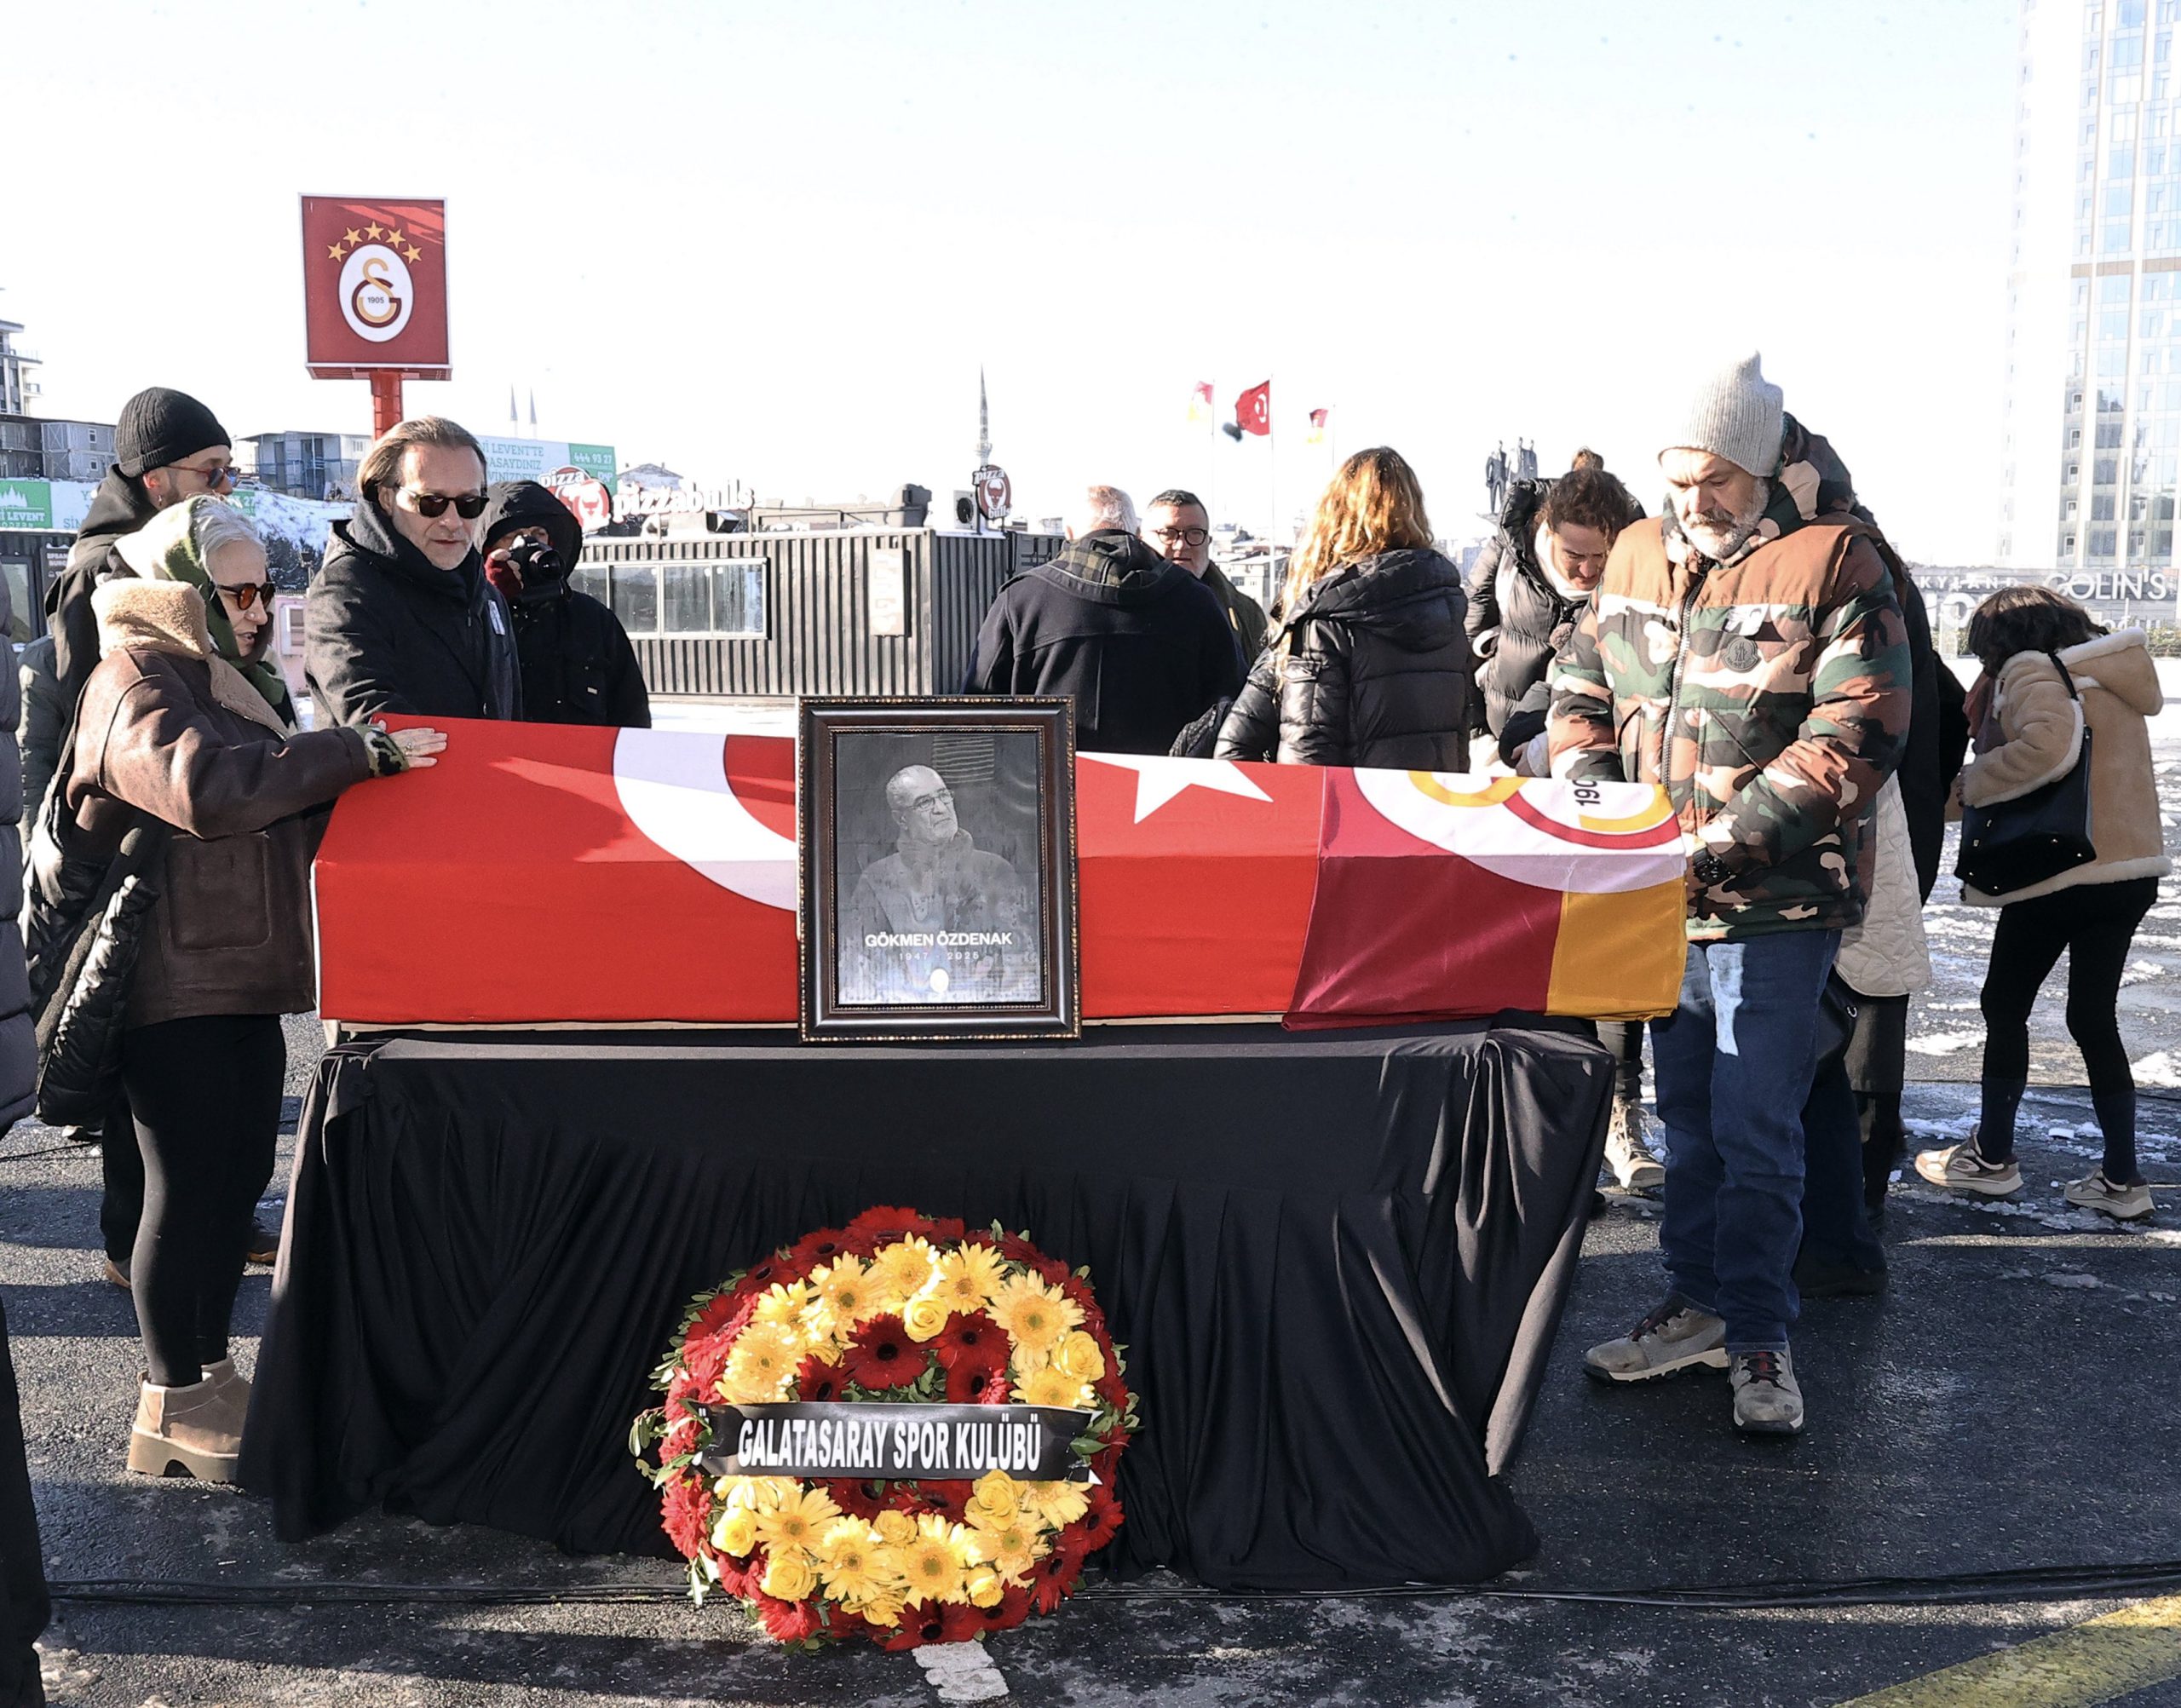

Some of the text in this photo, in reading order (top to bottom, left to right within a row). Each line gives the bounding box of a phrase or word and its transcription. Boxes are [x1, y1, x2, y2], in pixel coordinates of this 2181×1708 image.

[486, 457, 542, 470] ASAYDINIZ
[573, 452, 590, 464] 444
[603, 453, 613, 465] 27
[538, 468, 585, 488] pizza
[973, 466, 1005, 486] pizza
[613, 479, 755, 525] pizzabulls
[7, 511, 45, 522] LEVENT
[988, 503, 1011, 519] bulls
[1916, 576, 2019, 590] KYLAND
[2044, 569, 2167, 600] COLIN'S
[1572, 779, 1601, 806] 190
[865, 930, 1012, 946] GÖKMEN ÖZDENAK
[899, 952, 929, 961] 1947
[947, 952, 979, 960] 2025
[738, 1418, 889, 1469] GALATASARAY
[893, 1420, 949, 1470] SPOR
[955, 1412, 1041, 1471] KULÜBÜ
